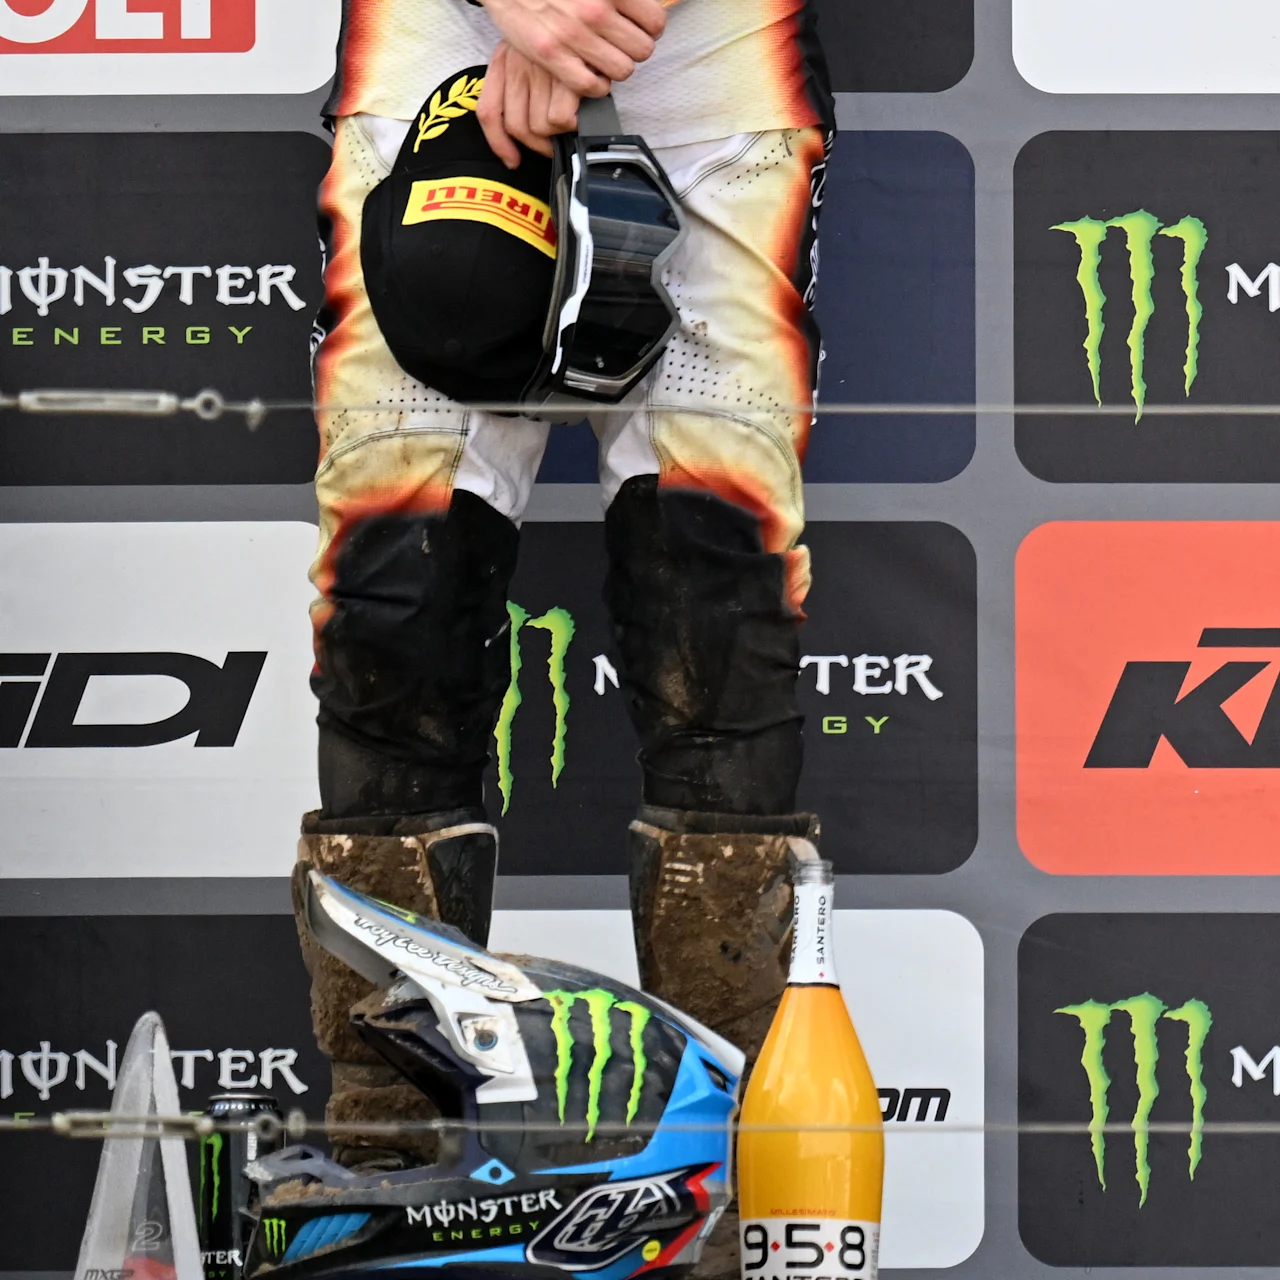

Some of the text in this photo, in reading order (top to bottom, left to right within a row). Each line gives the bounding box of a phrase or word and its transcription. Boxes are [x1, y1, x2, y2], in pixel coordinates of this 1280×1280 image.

[0, 256, 306, 314] ONSTER
[14, 326, 253, 345] ENERGY
[816, 895, 828, 965] SANTERO
[405, 1188, 563, 1228] MONSTER
[131, 1221, 163, 1252] 2
[432, 1220, 540, 1242] ENERGY
